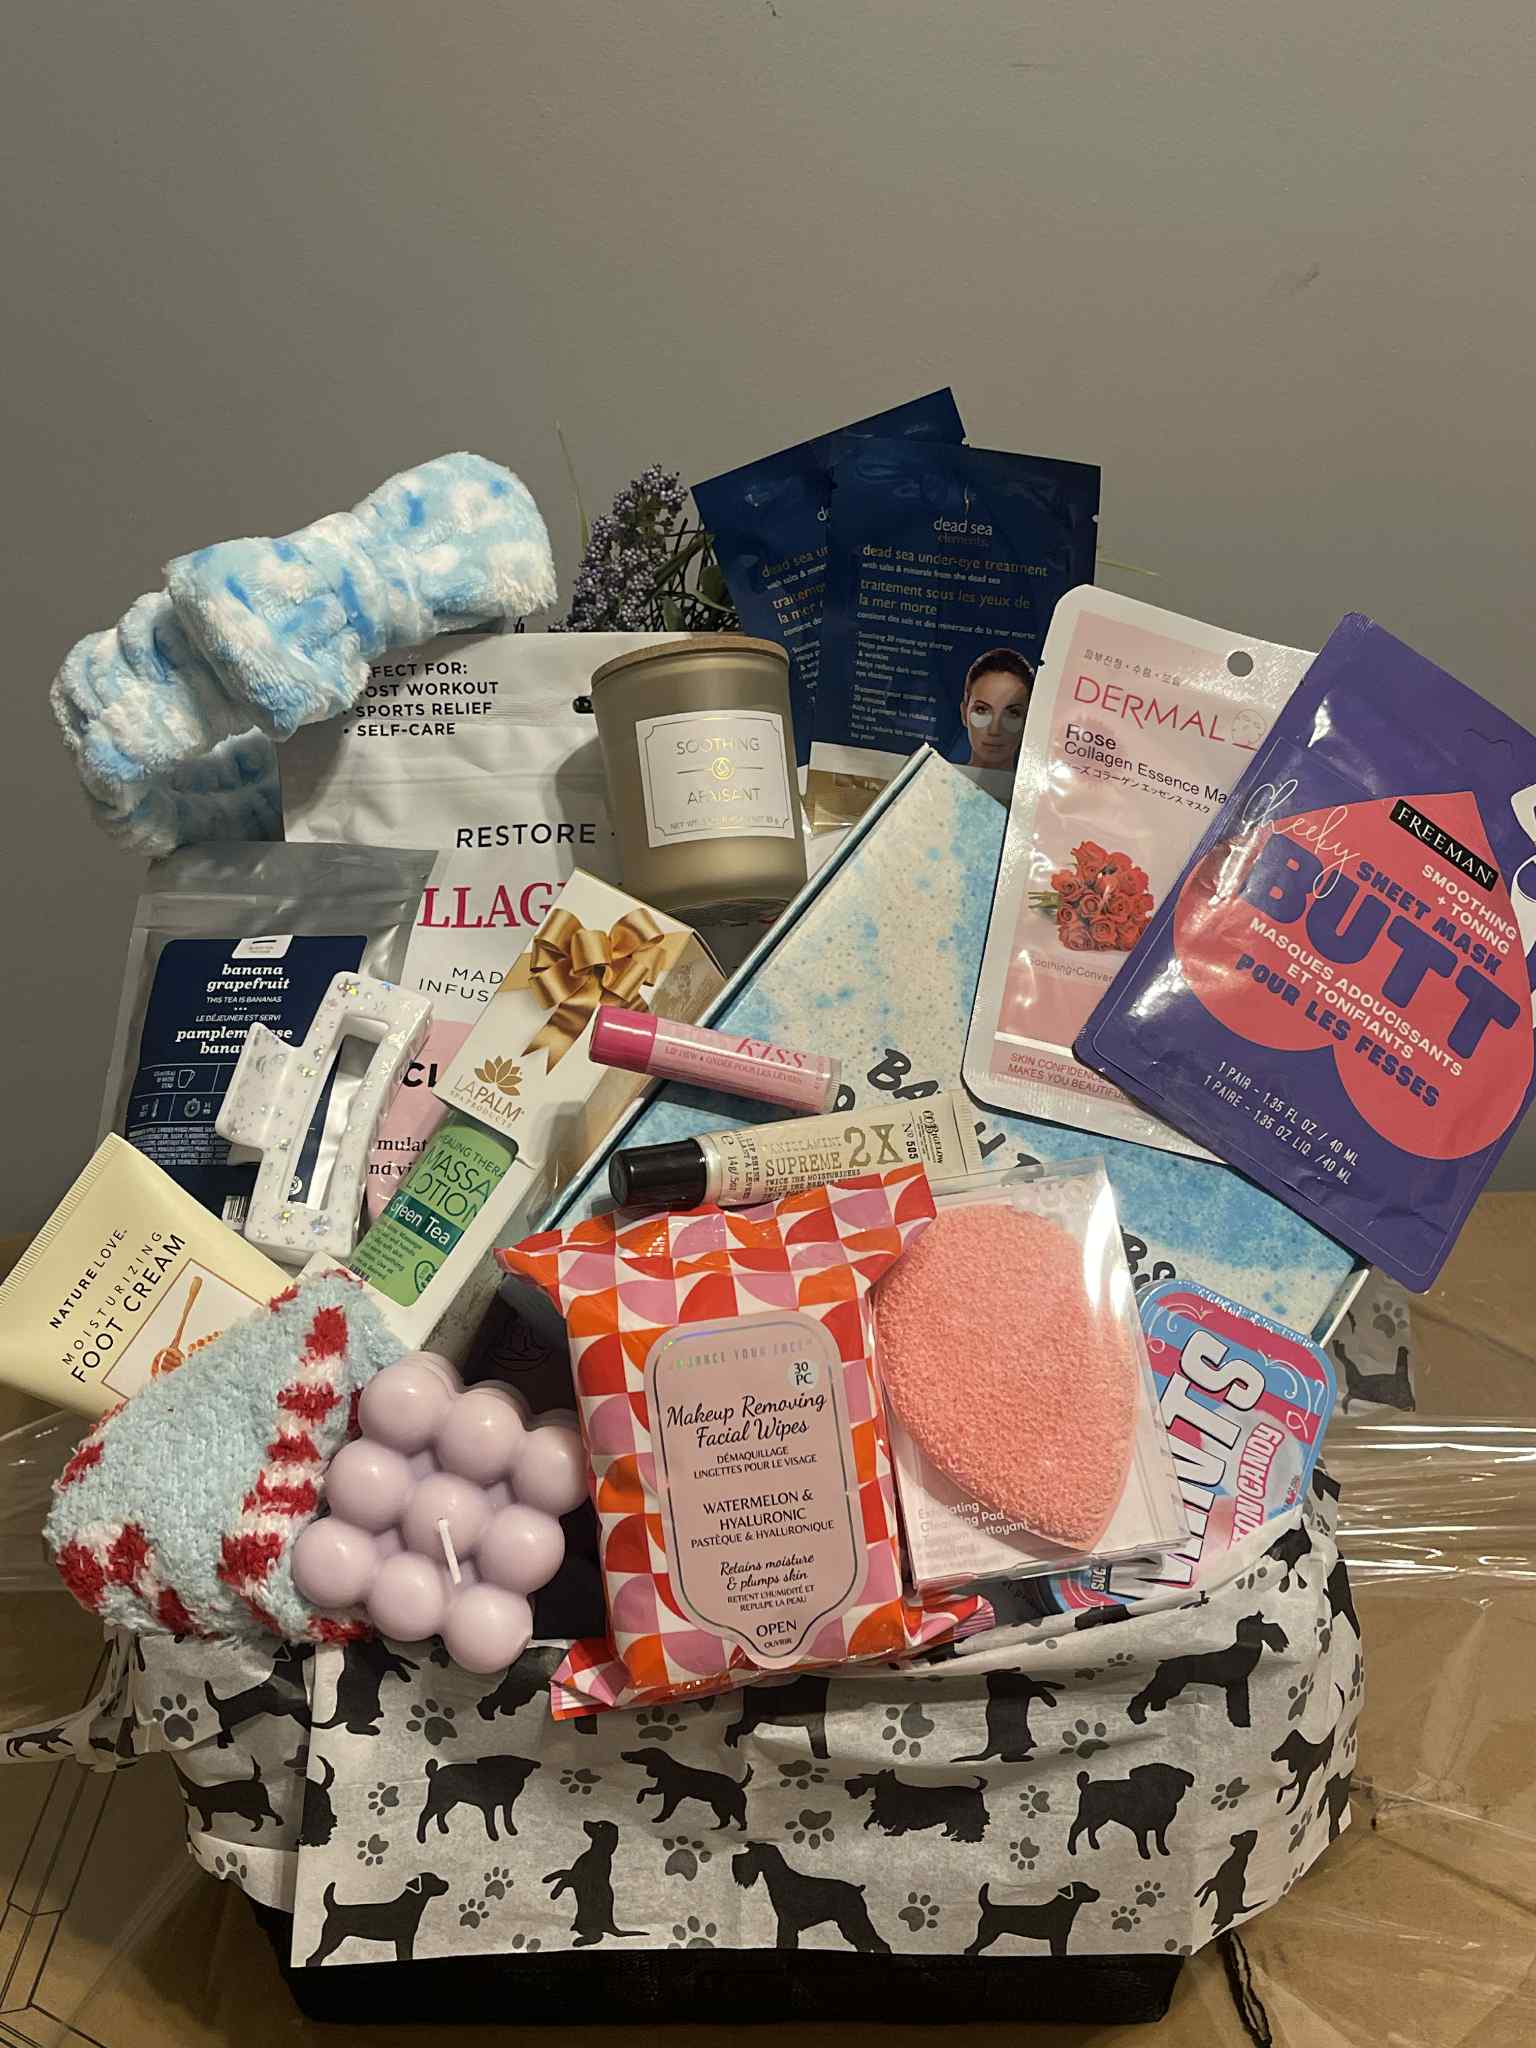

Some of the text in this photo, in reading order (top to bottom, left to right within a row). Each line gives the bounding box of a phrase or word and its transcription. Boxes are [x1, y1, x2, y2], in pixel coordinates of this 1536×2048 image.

[933, 516, 993, 536] dead sea
[862, 544, 893, 558] dead
[896, 550, 914, 561] sea
[985, 558, 1048, 577] treatment
[859, 593, 937, 616] la mer morte
[861, 578, 922, 597] traitement
[926, 588, 955, 601] sous
[979, 594, 1011, 608] yeux
[1014, 595, 1030, 609] de
[367, 662, 468, 680] FECT FOR:
[360, 681, 499, 698] OST WORKOUT
[355, 702, 493, 718] SPORTS RELIEF
[1073, 675, 1225, 743] DERMAL
[357, 723, 456, 737] SELF-CARE
[1066, 723, 1117, 751] Rose
[676, 736, 760, 756] SOOTHING
[1064, 740, 1134, 772] Collagen
[1138, 762, 1200, 796] Essence
[456, 823, 597, 849] RESTORE
[1397, 806, 1494, 885] FREEMAN
[416, 880, 567, 929] LLAG
[1421, 863, 1517, 941] SMOOTHING
[1356, 861, 1503, 977] SHEET MASK
[1436, 895, 1511, 955] + TONING
[1239, 833, 1521, 1059] BUTT
[222, 964, 283, 976] banana
[206, 977, 290, 993] grapefruit
[1250, 917, 1464, 1078] MASQUES ADOUCISSANTS
[247, 995, 282, 1003] BANANAS
[1287, 963, 1414, 1061] ET TONIFIANTS
[258, 1014, 281, 1022] SERVI
[1235, 953, 1440, 1109] POUR LES FESSES
[176, 1026, 293, 1042] pamplemse
[200, 1042, 245, 1054] bana
[1010, 1053, 1104, 1083] SKIN CONFIDENC
[1007, 1063, 1127, 1100] MAKES YOU BEAUTIFU
[1218, 1061, 1226, 1073] 1
[1227, 1065, 1253, 1090] PAIR
[1262, 1092, 1284, 1115] 1.35
[1285, 1104, 1297, 1124] FL
[1301, 1118, 1317, 1137] OZ
[1329, 1136, 1343, 1154] 40
[1347, 1147, 1360, 1167] ML
[1203, 1075, 1212, 1087] 1
[1212, 1079, 1243, 1110] PAIRE
[1252, 1110, 1274, 1131] 1.35
[1275, 1124, 1292, 1142] OZ
[1338, 1165, 1351, 1185] ML
[906, 1140, 919, 1160] 505
[765, 1151, 843, 1177] SUPREME
[425, 1214, 450, 1247] Tea
[62, 1231, 162, 1366] MOISTURIZING
[70, 1316, 124, 1384] FOOT
[122, 1233, 186, 1313] CREAM
[793, 1361, 809, 1375] 30
[795, 1373, 813, 1386] PC
[667, 1392, 826, 1429] Makeup Removing
[696, 1417, 809, 1448] Facial Wipes
[694, 1454, 817, 1479] LINGETTES POUR LE VISAGE
[717, 1446, 789, 1464] DÉMAQUILLAGE
[1237, 1423, 1285, 1499] CANDY
[703, 1488, 814, 1515] WATERMELON &
[719, 1508, 807, 1531] HYALURONIC
[981, 1510, 1005, 1524] Pad
[691, 1519, 835, 1548] PASTÈQUE & HYALURONIQUE
[720, 1553, 815, 1577] Retains moisture
[726, 1567, 808, 1591] & plumps skin
[727, 1591, 760, 1604] RETIENT
[804, 1584, 816, 1593] ET
[740, 1597, 807, 1612] REPULPE LA PEAU
[756, 1619, 798, 1638] OPEN
[764, 1637, 793, 1649] OUVRIR
